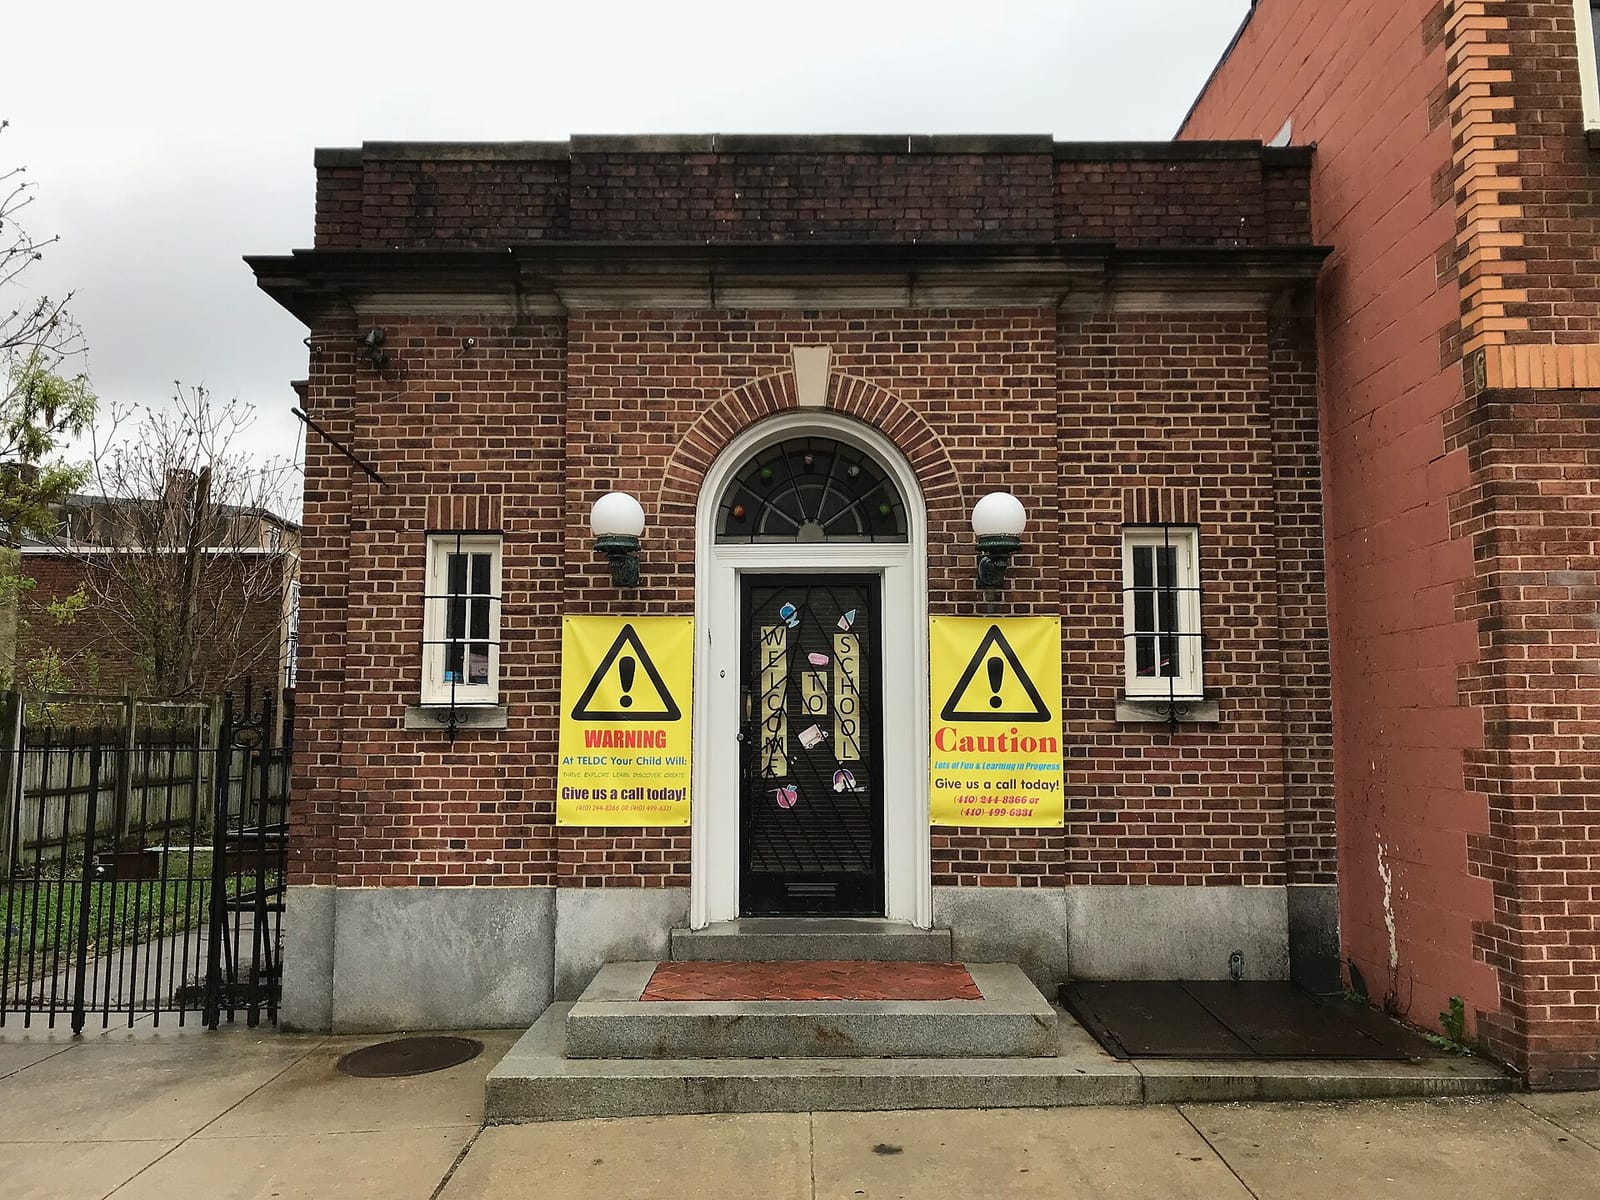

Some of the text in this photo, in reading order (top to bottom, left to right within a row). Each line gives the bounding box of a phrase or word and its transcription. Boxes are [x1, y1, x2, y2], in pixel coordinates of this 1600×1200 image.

[807, 674, 823, 712] TO
[840, 637, 856, 759] SCHOOL
[763, 629, 785, 776] WELCOME
[584, 730, 666, 748] WARNING
[935, 727, 1057, 752] Caution
[562, 757, 687, 765] At TELDC Your Child Will:
[982, 762, 1015, 771] Learning
[1025, 763, 1060, 771] Progress
[935, 778, 1059, 792] Give us a call today!
[562, 787, 686, 801] Give us a call today!
[954, 796, 977, 804] (410)
[980, 796, 1027, 804] 244-8366
